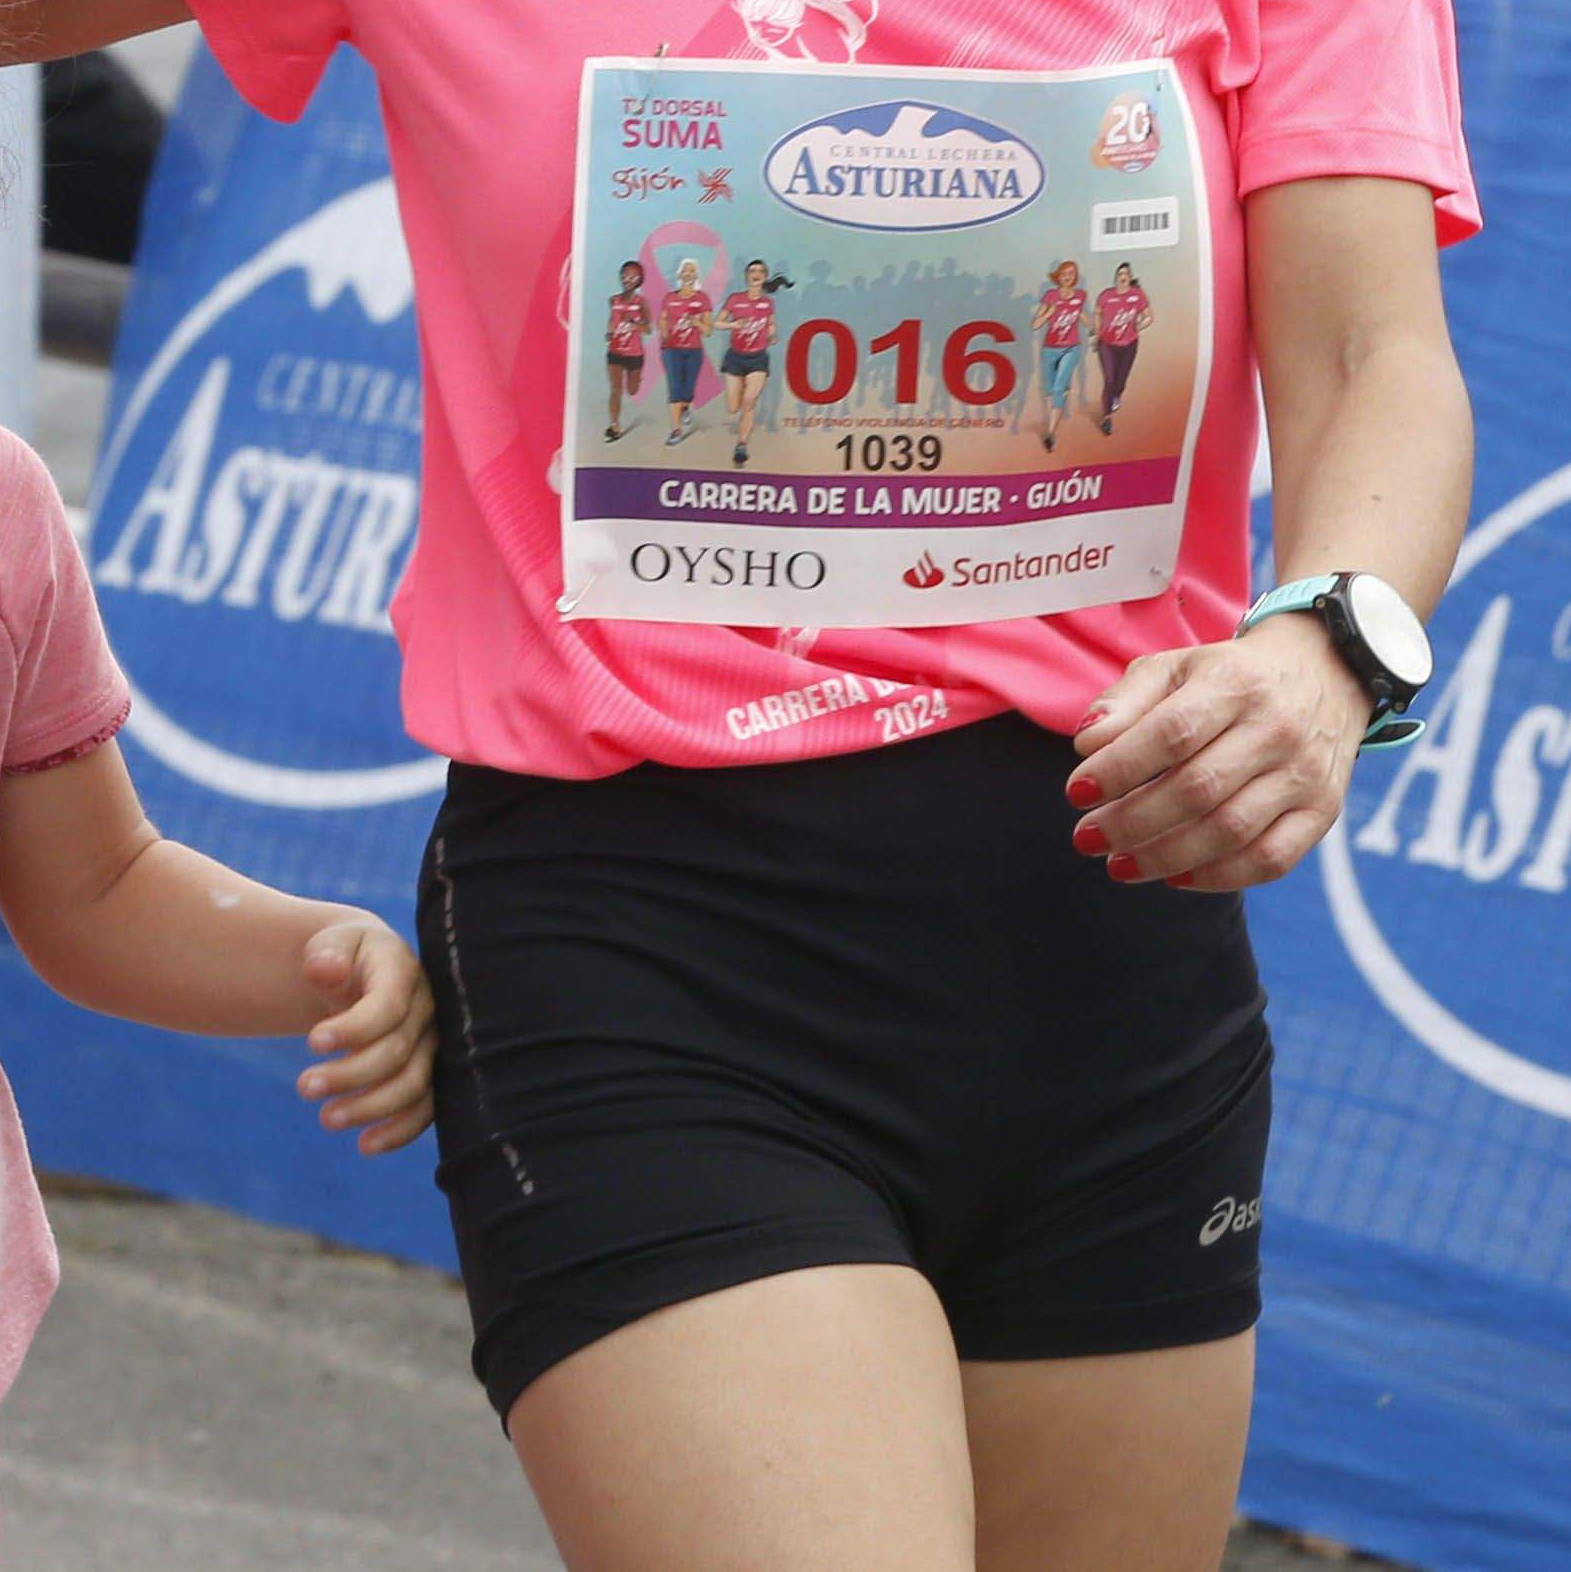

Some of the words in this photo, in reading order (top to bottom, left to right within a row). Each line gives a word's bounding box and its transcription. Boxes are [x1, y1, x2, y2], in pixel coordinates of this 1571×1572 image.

[651, 99, 728, 117] DORSAL
[1104, 102, 1150, 145] 20
[621, 118, 723, 150] SUMA
[830, 144, 918, 160] CENTRAL
[927, 148, 1018, 161] LECHERA
[784, 146, 1024, 200] ASTURIANA
[785, 318, 1017, 406] 016
[835, 434, 943, 472] 1039
[94, 355, 418, 636] ASTUR
[659, 480, 798, 515] CARRERA
[806, 486, 847, 516] DE
[854, 486, 893, 516] LA
[901, 486, 1001, 516] MUJER
[1027, 470, 1103, 510] GIJÓN
[630, 542, 826, 591] OYSHO
[951, 542, 1115, 587] Santander
[726, 672, 869, 740] CARRERA
[874, 688, 950, 743] 2024
